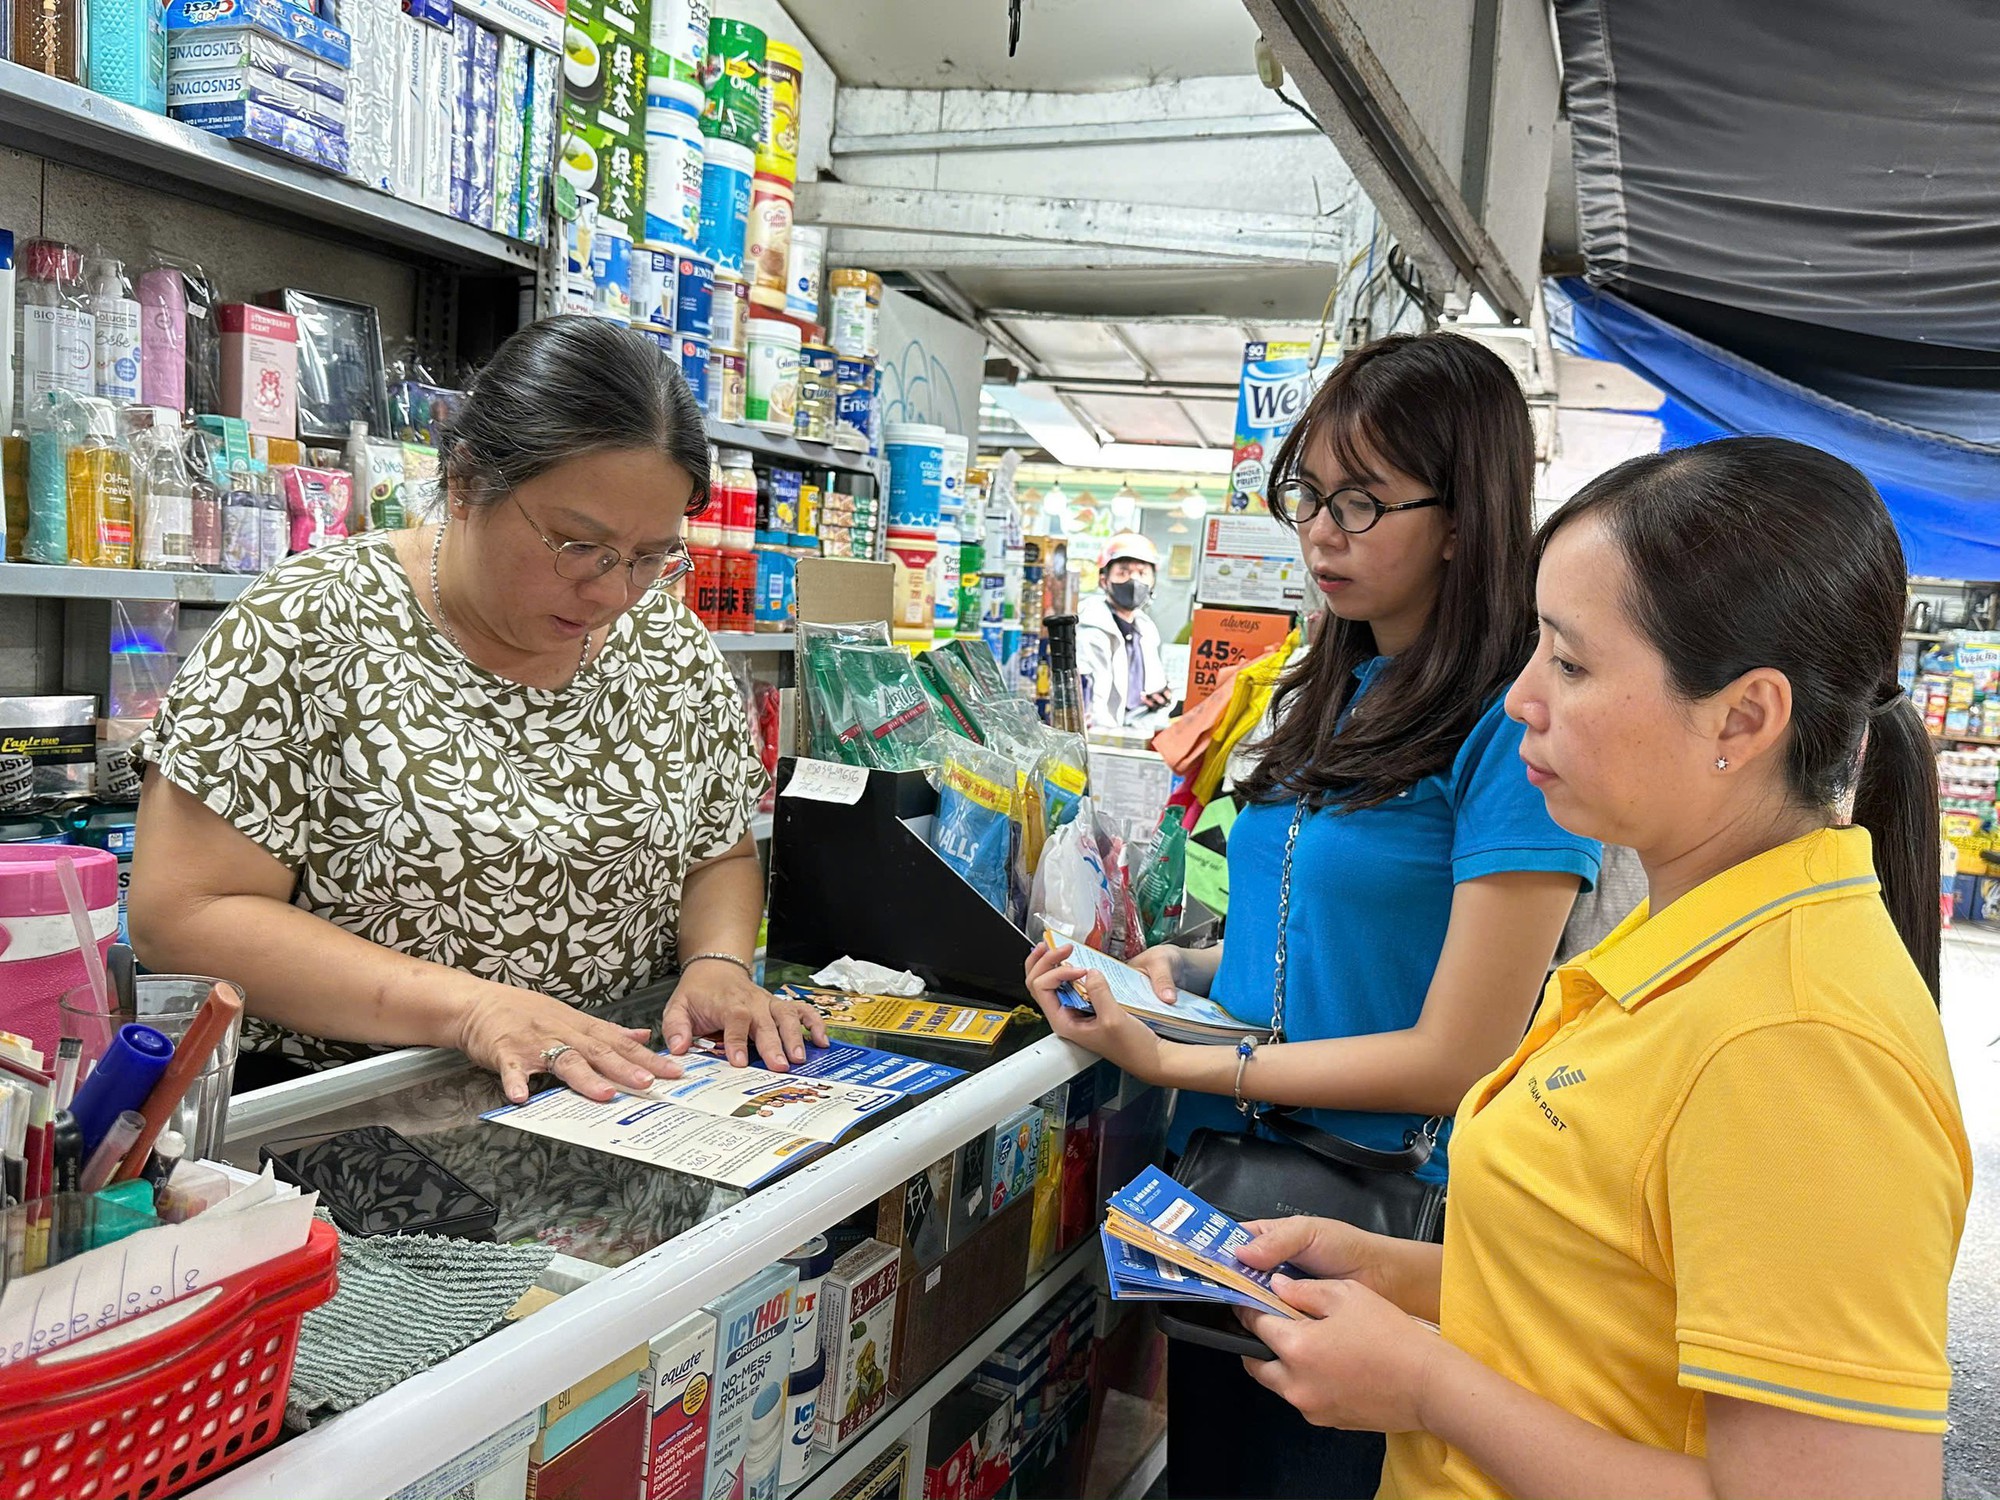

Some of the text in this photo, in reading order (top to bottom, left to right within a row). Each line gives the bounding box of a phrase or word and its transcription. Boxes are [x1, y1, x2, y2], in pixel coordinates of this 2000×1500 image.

[170, 41, 243, 60] SENSODYNE
[412, 28, 420, 86] SENSODYNE
[440, 41, 448, 98] SENSODYNE
[169, 78, 242, 96] SENSODYNE
[250, 323, 271, 334] SCENT
[1219, 614, 1261, 634] always
[1196, 639, 1247, 661] 45%
[1, 735, 41, 752] Eagle
[1539, 1101, 1567, 1132] POST
[686, 1152, 712, 1169] 10%
[735, 1328, 778, 1360] ORIGINAL
[661, 1352, 702, 1387] equate
[721, 1350, 772, 1393] NO-MESS
[718, 1384, 761, 1420] PAIN RELIEF
[719, 1380, 748, 1408] ROLL
[749, 1366, 766, 1386] ON
[654, 1426, 703, 1465] Hydrocortisone
[653, 1441, 706, 1484] Intensive Healing
[654, 1455, 675, 1475] Cream
